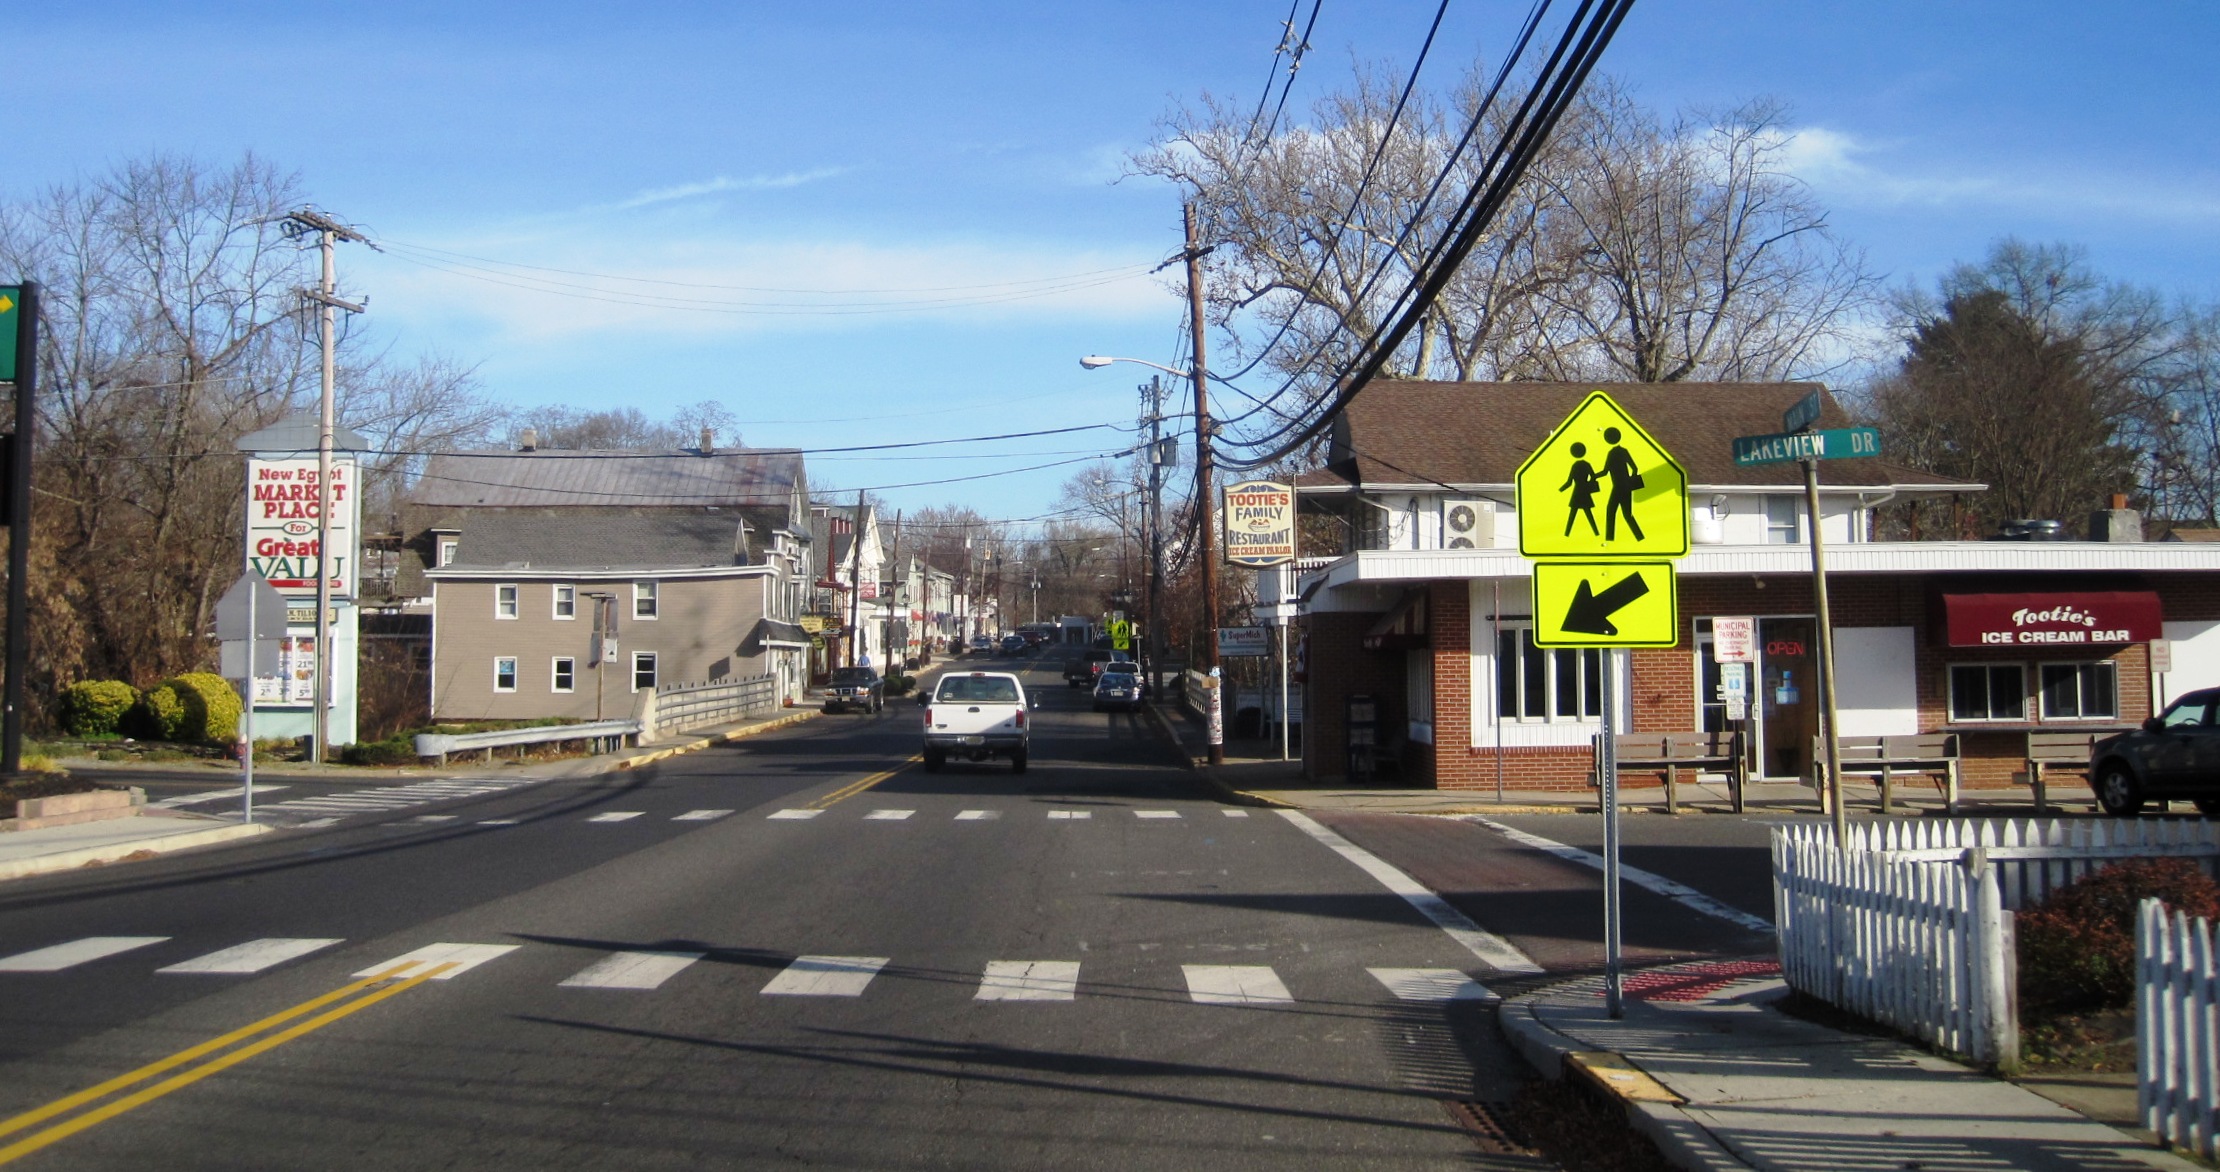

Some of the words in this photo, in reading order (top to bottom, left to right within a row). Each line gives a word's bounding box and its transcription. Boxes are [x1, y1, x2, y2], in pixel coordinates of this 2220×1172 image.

[1740, 435, 1825, 462] LAKEVIEW
[1851, 431, 1875, 453] DR
[259, 468, 293, 480] New
[254, 484, 346, 501] MARKT
[1228, 493, 1289, 506] TOOTIE'S
[1235, 506, 1283, 521] FAMILY
[290, 524, 306, 532] For
[1229, 528, 1290, 545] RESTAURANT
[256, 538, 320, 556] Great
[1229, 547, 1240, 556] ICE
[1241, 546, 1265, 555] CREAM
[1266, 545, 1292, 554] PARLOR
[2012, 606, 2097, 627] Tootie's
[1716, 621, 1750, 630] MUNICIPAL
[1228, 630, 1261, 640] SuperMich
[1719, 631, 1748, 639] PARKING
[1981, 632, 2013, 643] ICE
[2018, 631, 2085, 643] CREAM
[2091, 630, 2129, 642] BAR
[1767, 642, 1804, 655] OPEN
